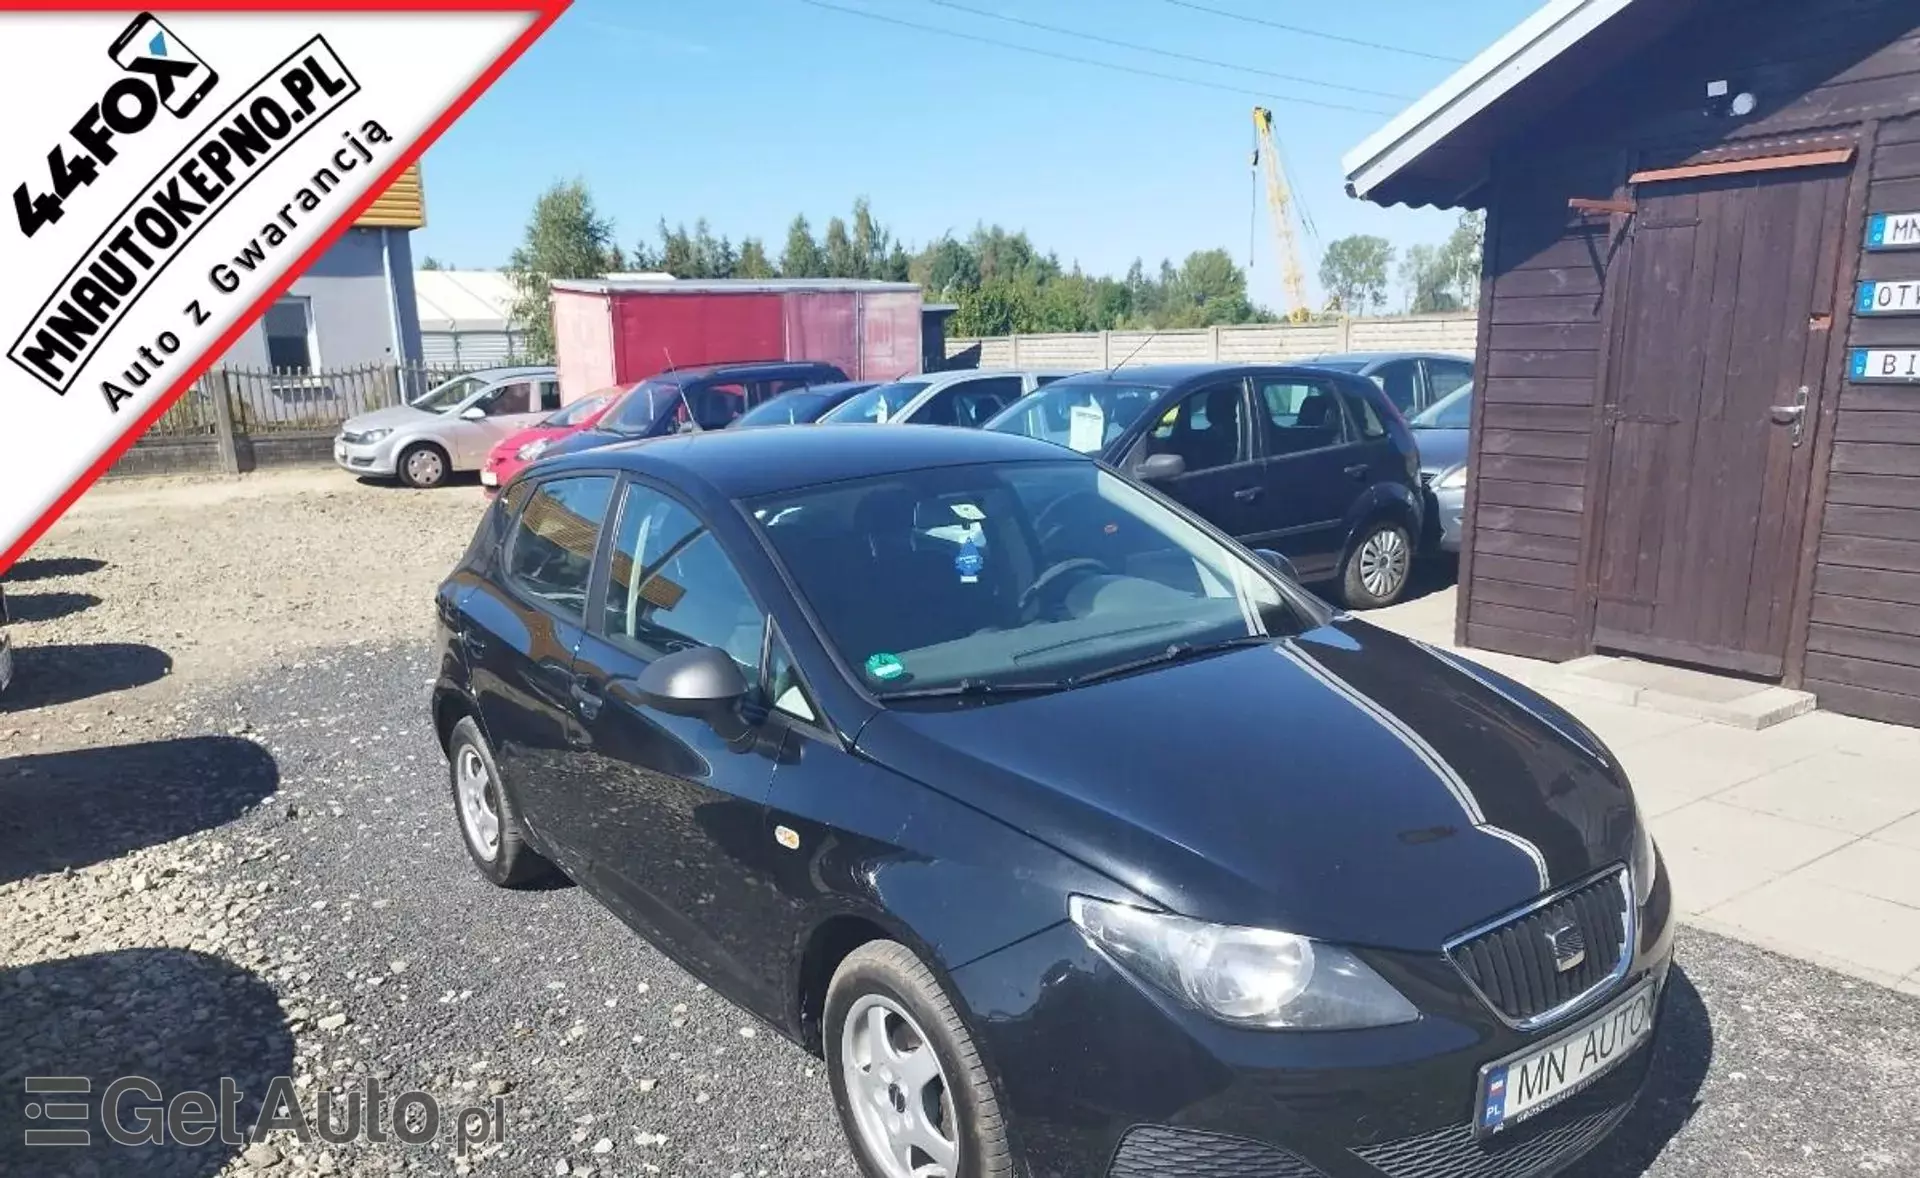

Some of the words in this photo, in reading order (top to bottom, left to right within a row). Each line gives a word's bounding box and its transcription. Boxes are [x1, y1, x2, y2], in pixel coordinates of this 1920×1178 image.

[1517, 1044, 1568, 1105] MN
[1579, 995, 1646, 1074] AUTO
[1486, 1104, 1502, 1120] PL
